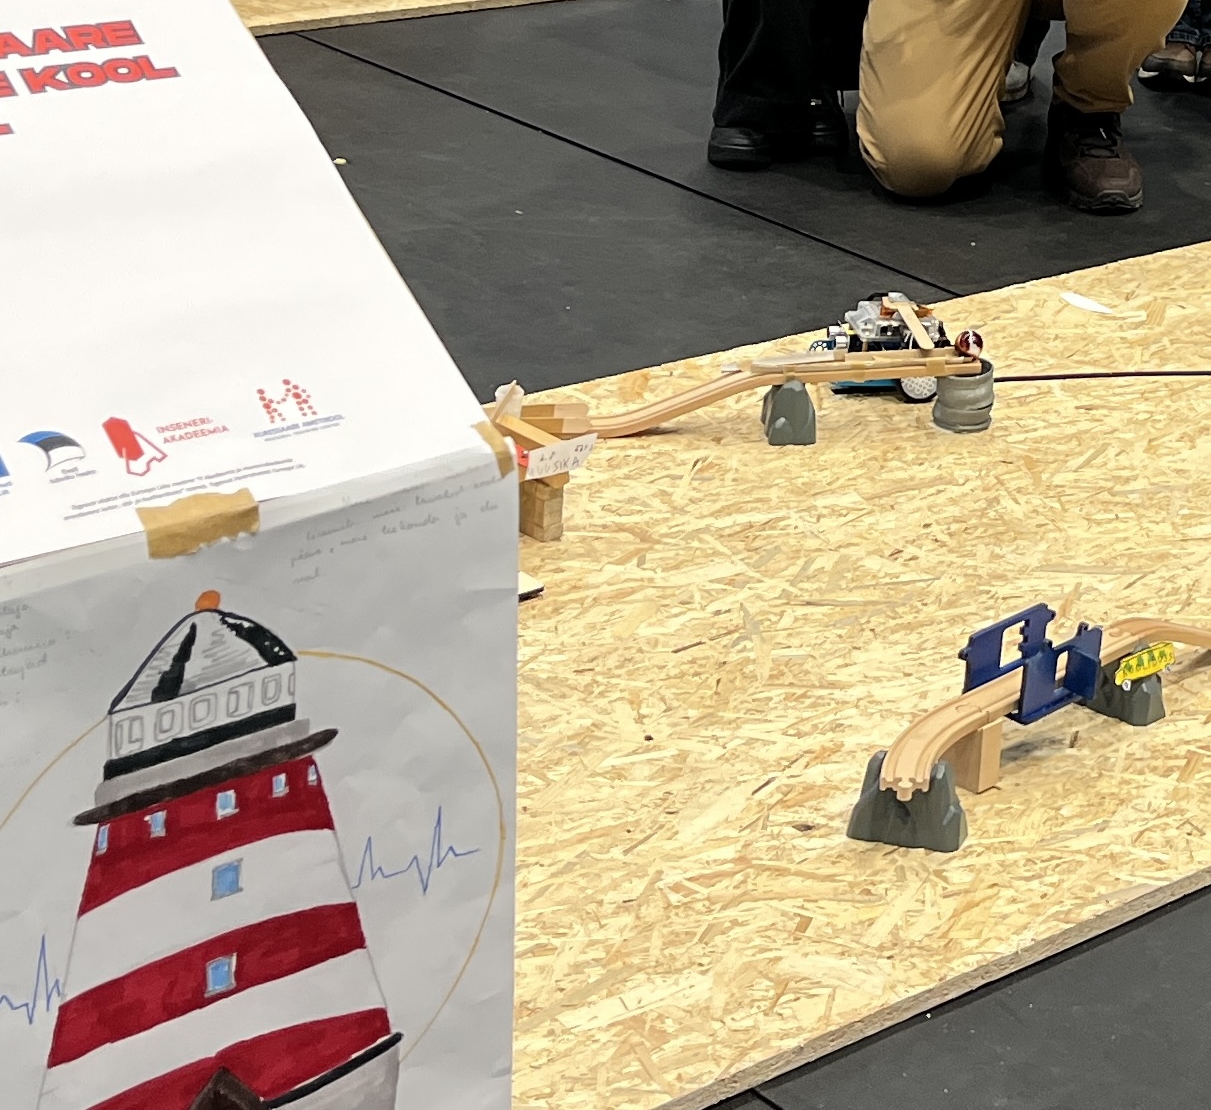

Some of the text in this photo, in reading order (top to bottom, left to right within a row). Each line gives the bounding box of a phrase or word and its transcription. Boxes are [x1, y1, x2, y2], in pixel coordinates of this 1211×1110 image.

[0, 20, 145, 59] AARE
[17, 55, 181, 94] KOOL
[163, 425, 230, 444] AKADEEMIA
